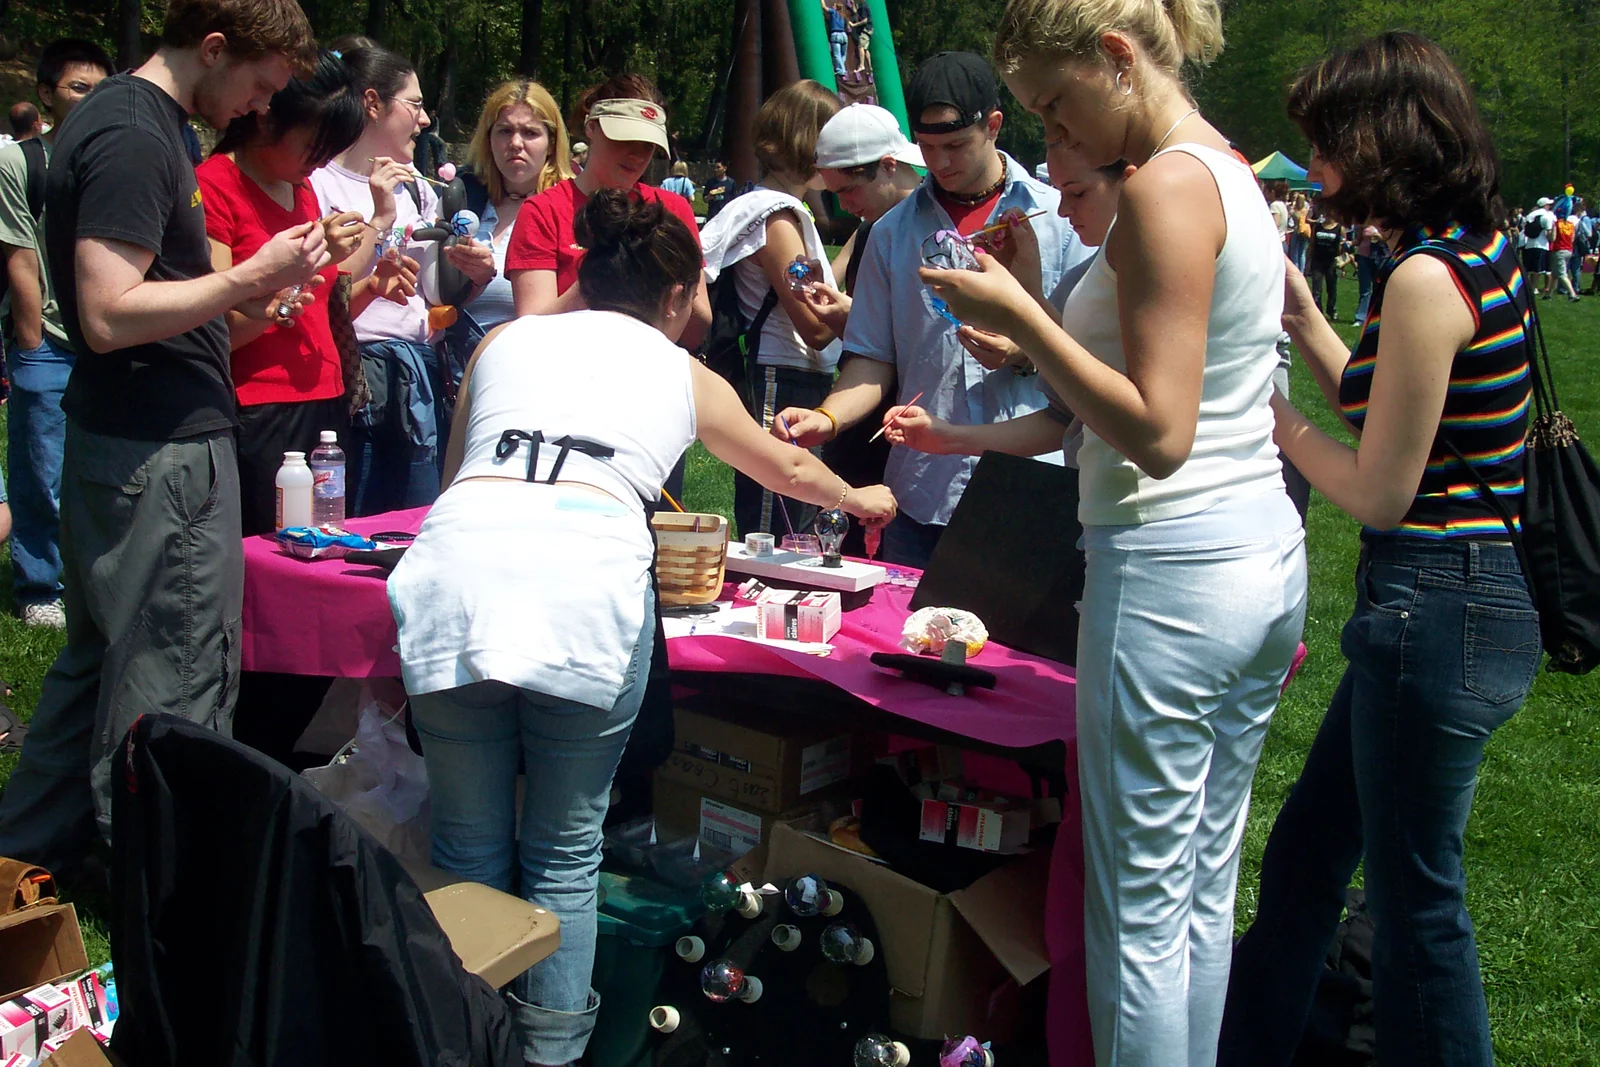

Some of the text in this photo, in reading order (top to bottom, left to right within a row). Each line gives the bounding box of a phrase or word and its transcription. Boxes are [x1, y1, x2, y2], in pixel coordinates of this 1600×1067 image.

[946, 807, 954, 831] claires
[978, 813, 986, 846] SYLVANIA
[71, 986, 84, 1018] SYLVANIA
